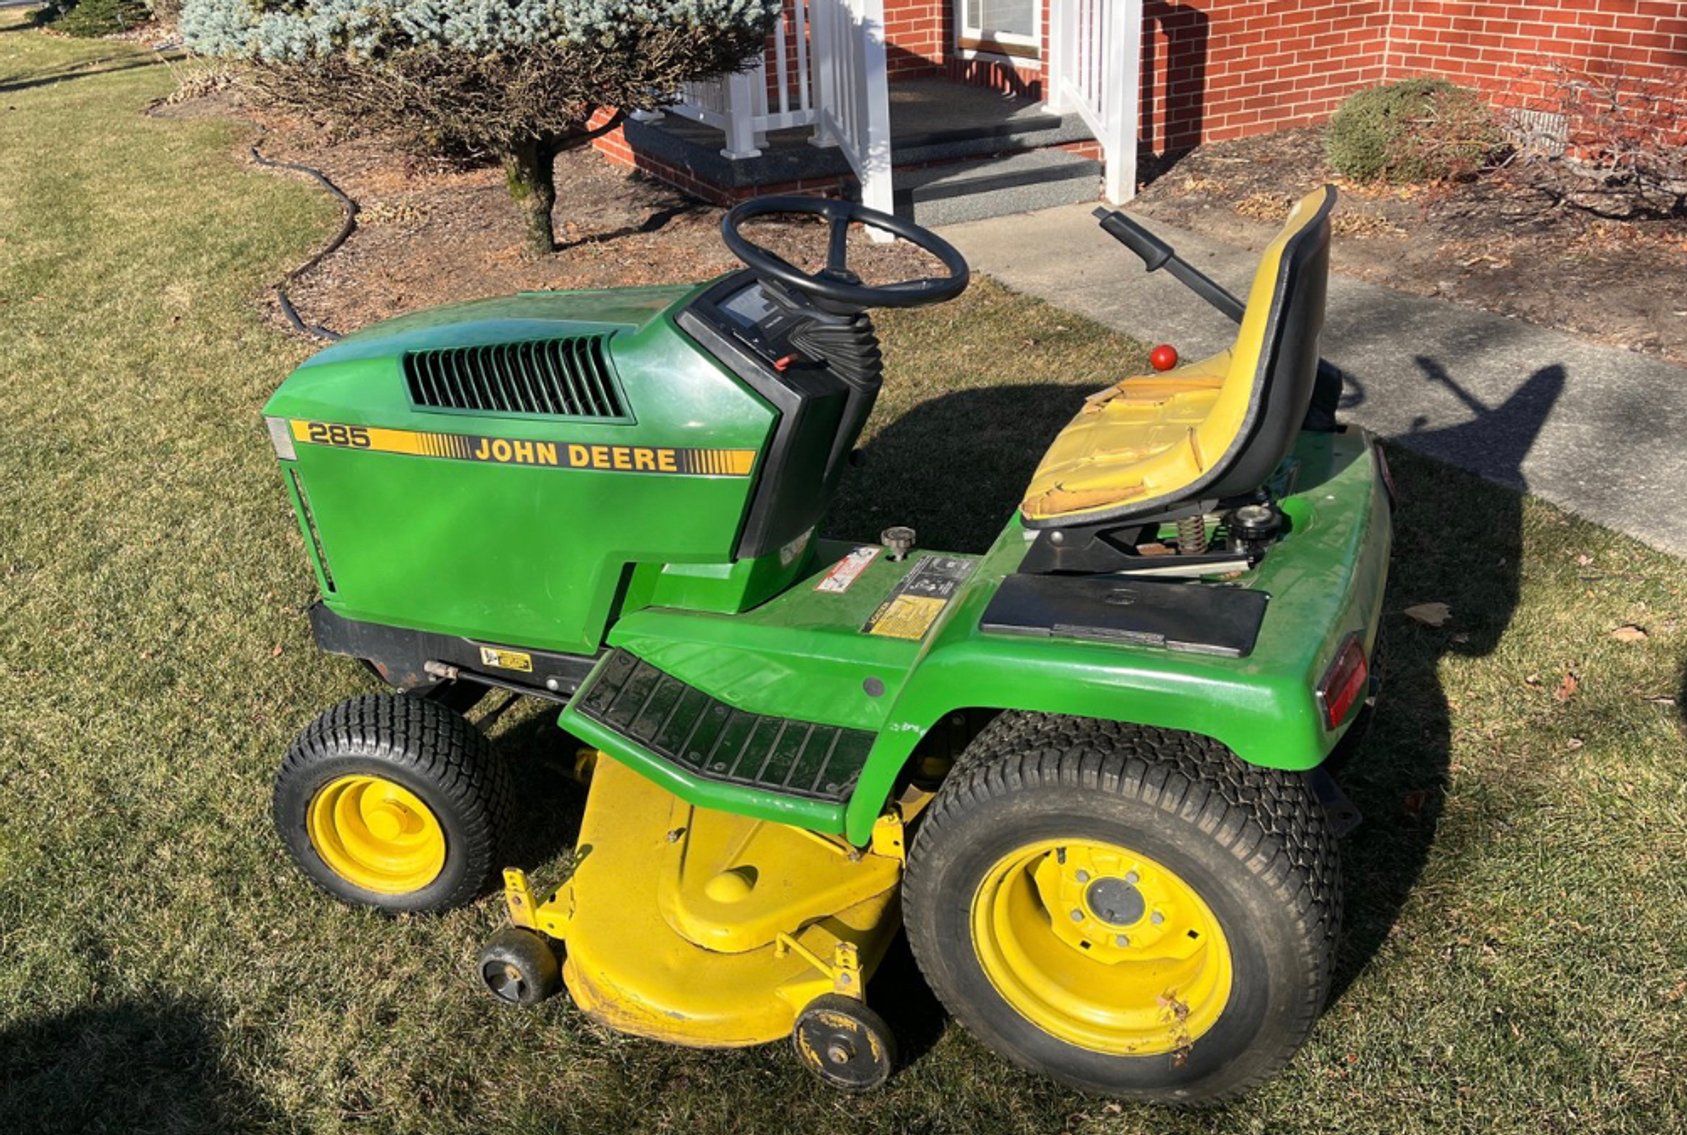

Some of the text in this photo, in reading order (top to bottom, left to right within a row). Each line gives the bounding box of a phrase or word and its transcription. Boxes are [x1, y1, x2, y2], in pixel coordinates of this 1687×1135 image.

[308, 422, 371, 448] 285
[475, 438, 678, 472] JOHN DEERE
